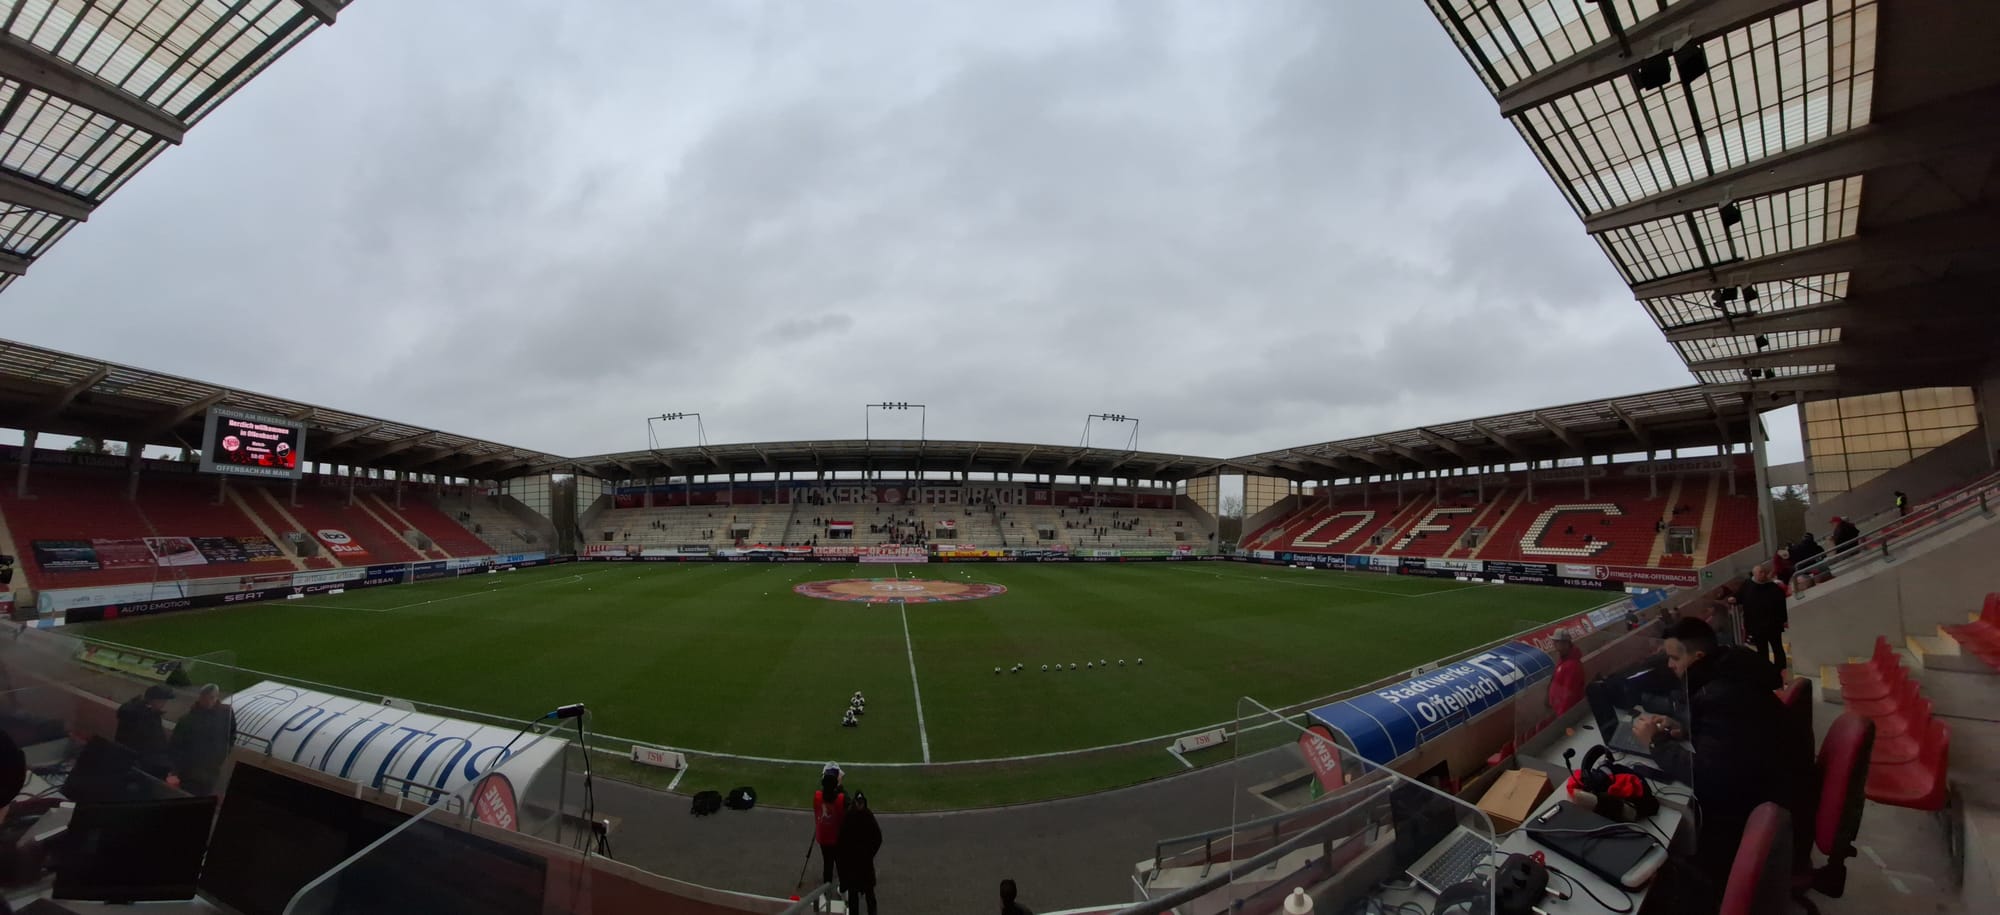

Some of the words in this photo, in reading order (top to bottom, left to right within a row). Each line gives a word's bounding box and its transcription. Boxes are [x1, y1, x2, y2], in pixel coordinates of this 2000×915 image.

[213, 407, 243, 417] STADION
[245, 412, 255, 420] AM
[228, 419, 254, 429] Herzlich
[254, 424, 290, 435] willkommen
[247, 430, 279, 441] Offenbach!
[215, 464, 260, 474] OFFENBACH
[272, 469, 290, 477] MAIN
[789, 487, 877, 504] KICKERS
[907, 486, 1026, 505] OFFENBACH
[322, 531, 346, 540] iba
[1291, 510, 1376, 548] O
[1392, 507, 1476, 550] F
[1520, 503, 1622, 556] C
[1293, 553, 1316, 562] Energie
[363, 577, 394, 585] NISSAN
[1508, 575, 1543, 583] CUPRA
[1564, 578, 1602, 587] NISSAN
[1609, 570, 1697, 583] FITNESS-PARK-OFFENBACH.DE
[306, 582, 345, 593] CUPRA
[224, 591, 264, 602] SEAT
[121, 604, 148, 615] AUTO
[149, 600, 191, 611] EMOTION
[1379, 663, 1475, 704] Stadtwerke
[1416, 677, 1497, 724] Offenbach
[1194, 735, 1211, 744] TSW
[647, 751, 665, 763] TSW
